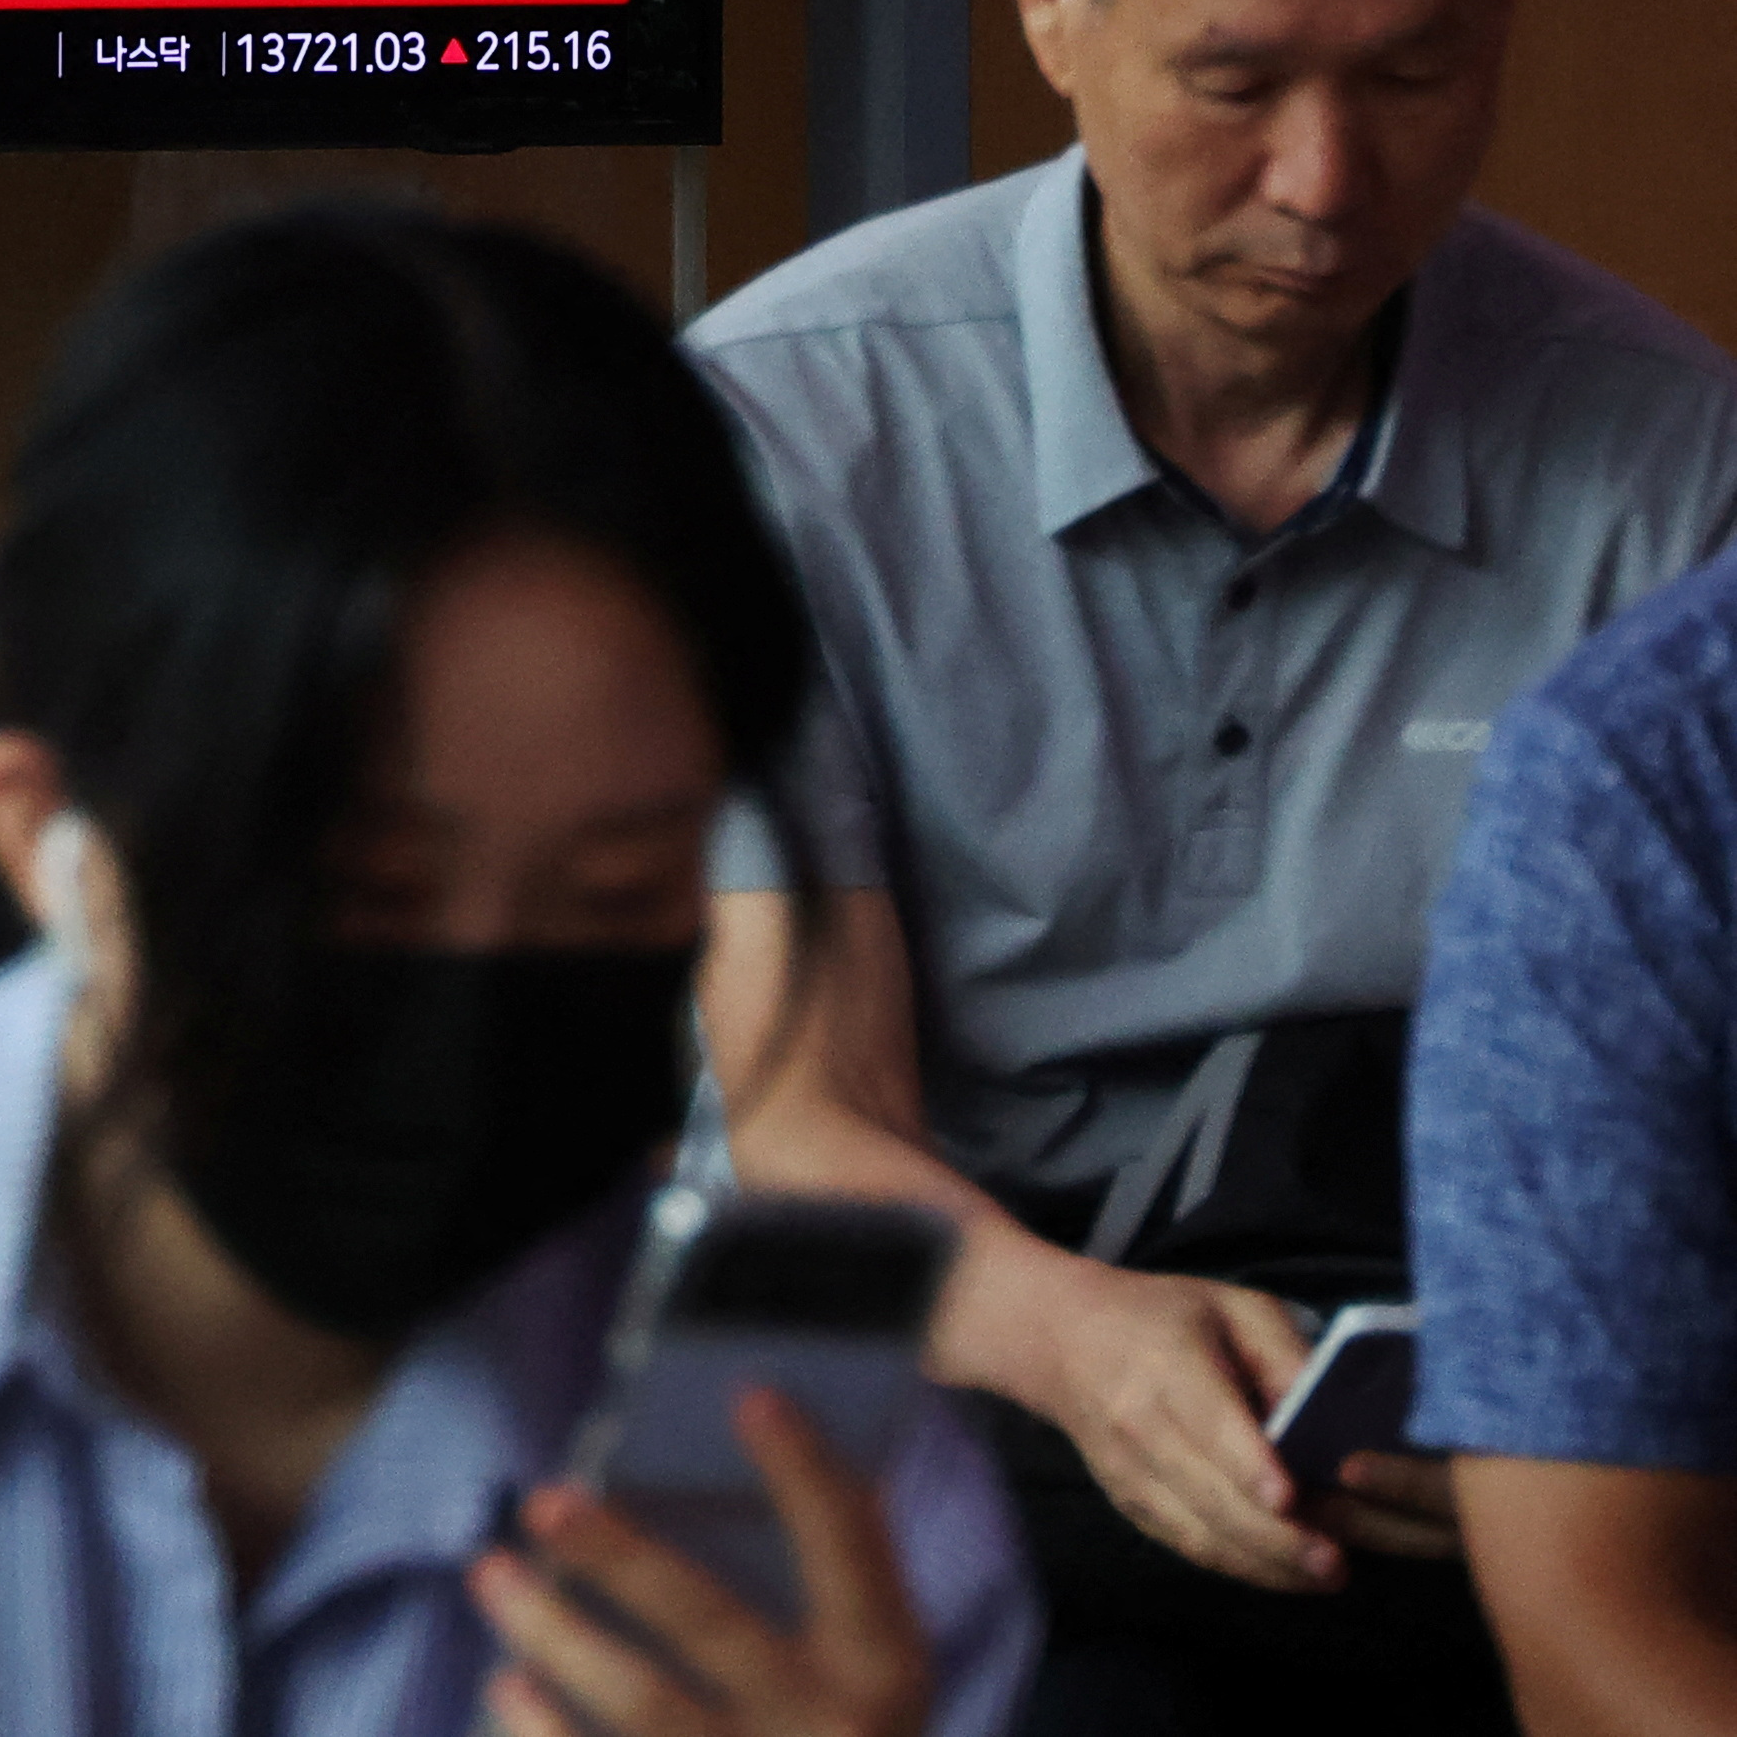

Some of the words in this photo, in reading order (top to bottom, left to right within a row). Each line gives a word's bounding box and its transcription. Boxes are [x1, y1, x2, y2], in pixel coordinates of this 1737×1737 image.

[97, 36, 190, 72] 나스닥
[238, 32, 425, 72] 13721.03
[477, 30, 610, 71] 215.16
